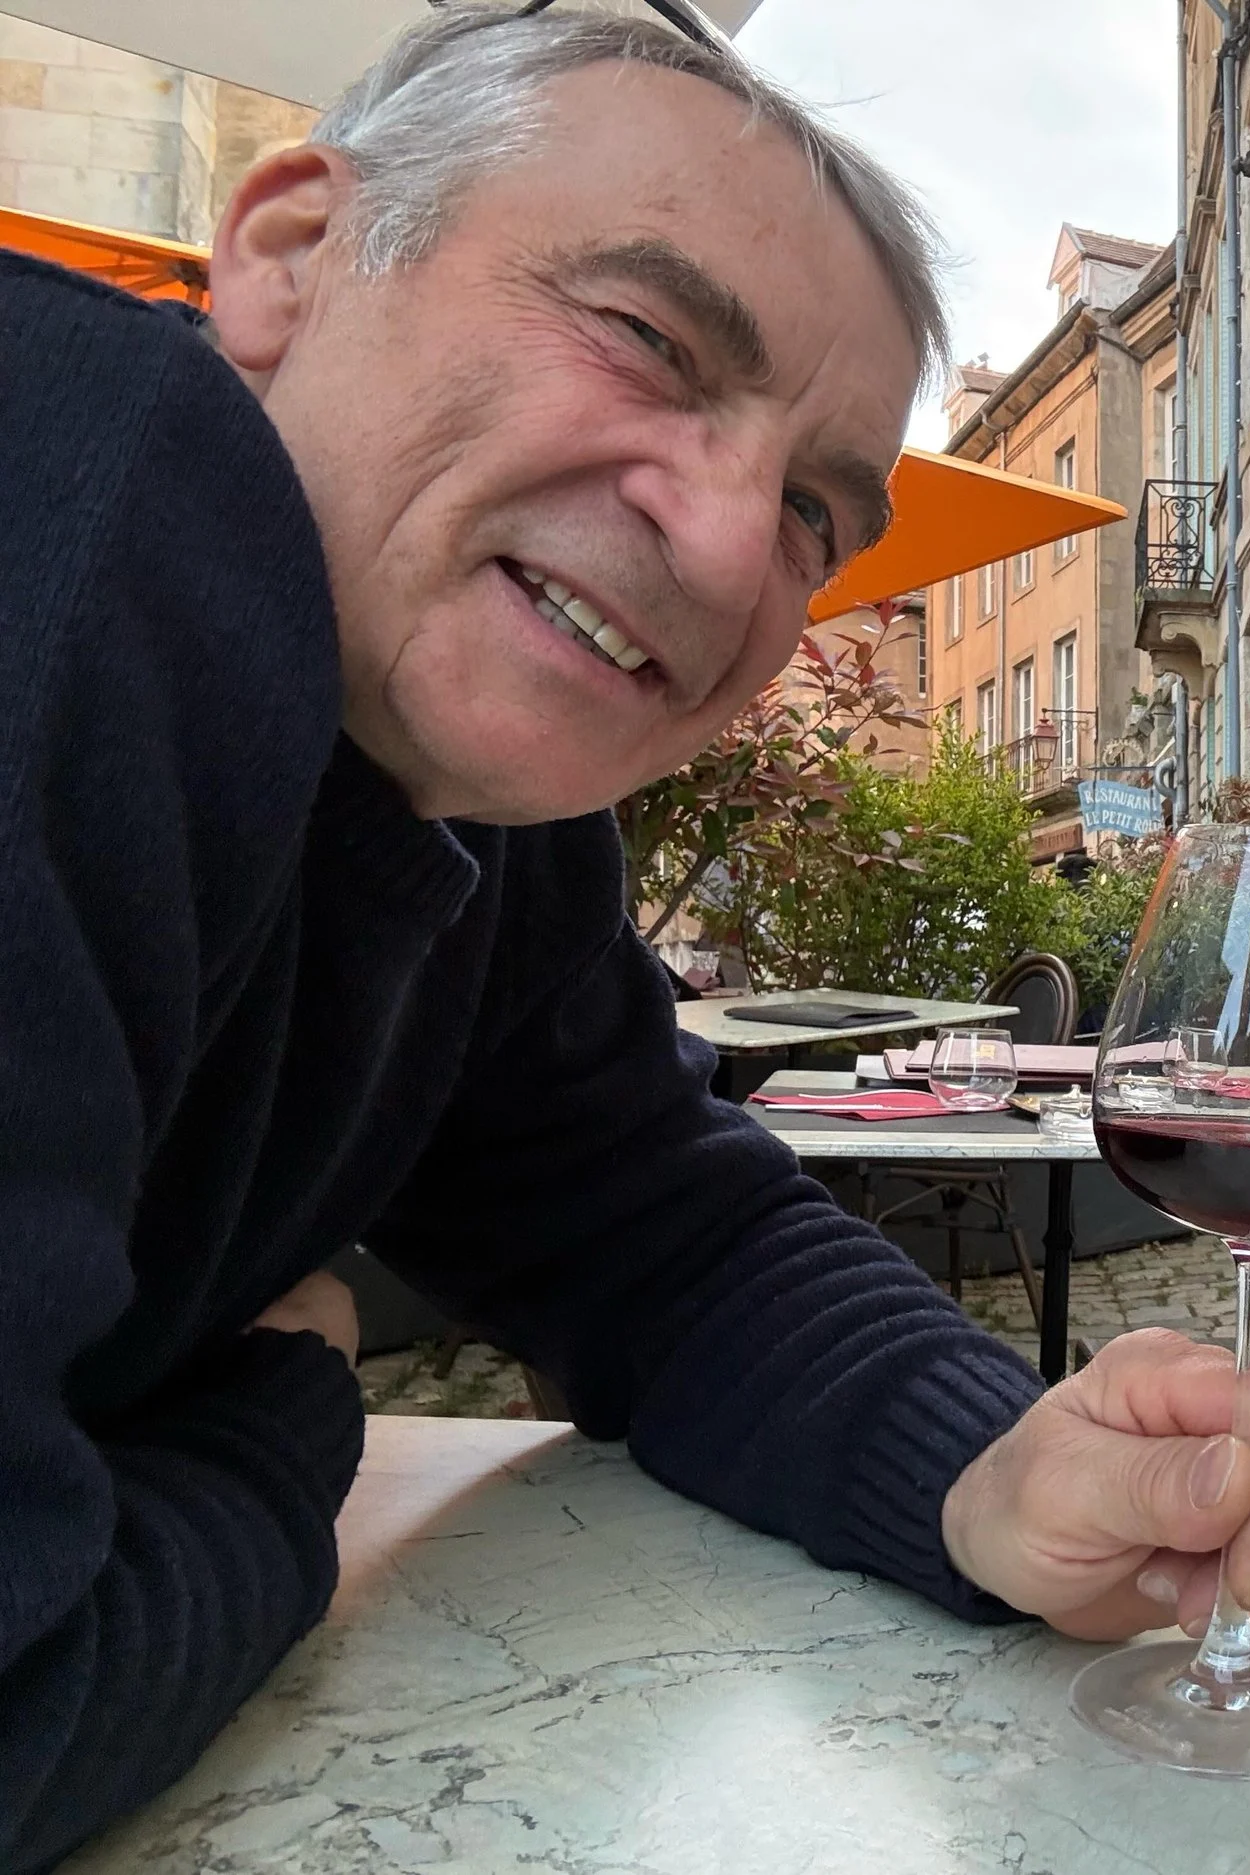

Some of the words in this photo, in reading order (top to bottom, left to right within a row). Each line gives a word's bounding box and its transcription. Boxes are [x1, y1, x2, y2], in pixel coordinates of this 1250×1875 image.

[1084, 787, 1157, 811] RESTAURANT
[1085, 811, 1100, 827] LE
[1102, 809, 1132, 829] PETIT
